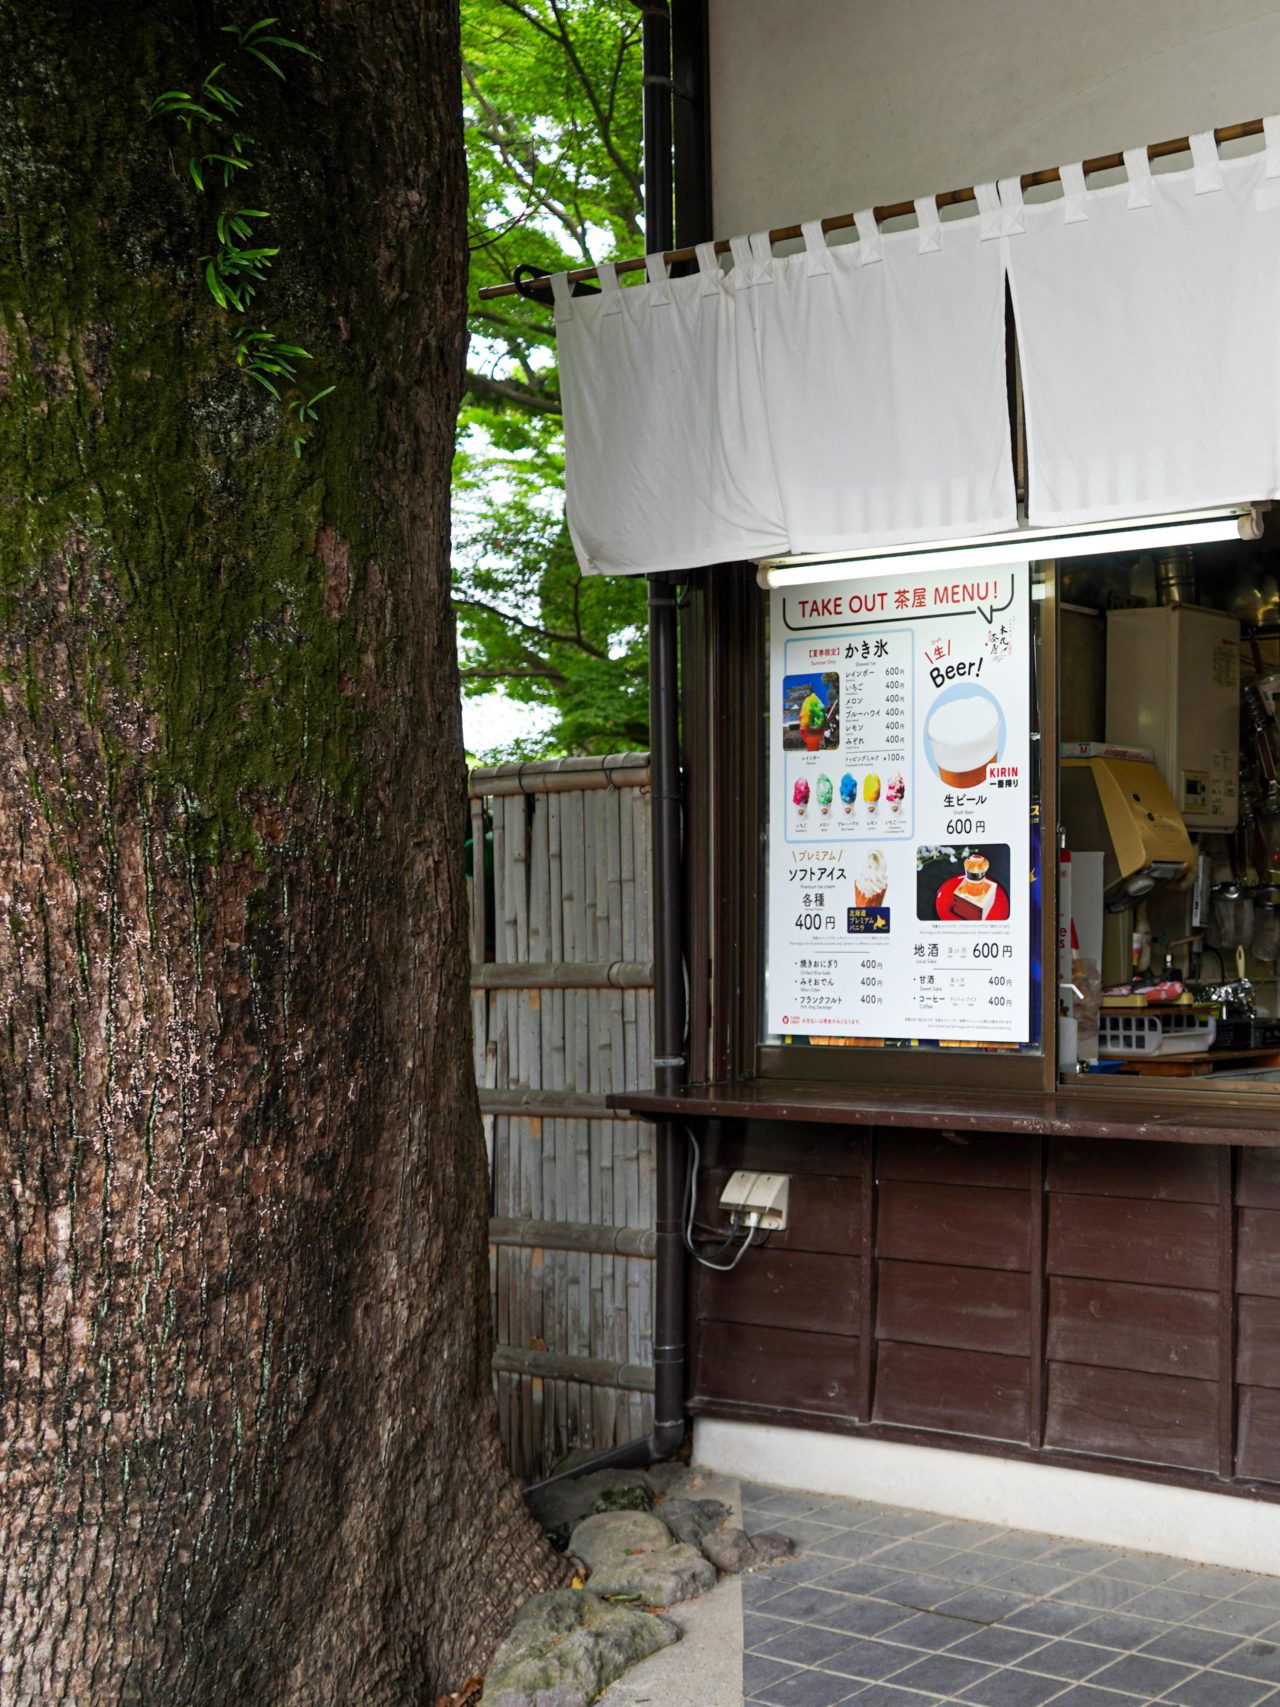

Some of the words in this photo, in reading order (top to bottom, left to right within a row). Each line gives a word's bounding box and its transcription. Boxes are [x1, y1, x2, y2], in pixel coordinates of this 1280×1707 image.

[798, 596, 843, 618] TAKE
[849, 592, 888, 614] OUT
[894, 587, 927, 610] 茶屋
[844, 638, 889, 659] かき氷
[933, 645, 946, 661] 生
[845, 668, 875, 678] レインボー
[885, 667, 904, 676] 600円
[929, 657, 983, 689] Beer!
[845, 683, 863, 692] いちご
[885, 680, 904, 689] 400円
[845, 697, 863, 705] メロン
[885, 694, 904, 703] 400円
[845, 708, 880, 718] ブルーハワイ
[885, 708, 904, 716] 400円
[845, 723, 864, 732] レモン
[885, 721, 904, 730] 400円
[845, 737, 865, 745] みぞれ
[885, 735, 904, 743] 400円
[989, 766, 1019, 778] KIRIN
[989, 779, 1019, 788] 一番搾り
[943, 793, 988, 808] 生ビール
[799, 849, 836, 861] プレミアム
[789, 867, 847, 882] ソフトアイス
[802, 892, 825, 907] 各種
[913, 943, 939, 957] 地酒
[800, 959, 838, 969] 焼きおにぎり
[800, 978, 835, 987] みそおでん
[919, 975, 935, 985] 甘酒
[800, 996, 842, 1005] フランクフルト
[919, 995, 945, 1003] コーヒー
